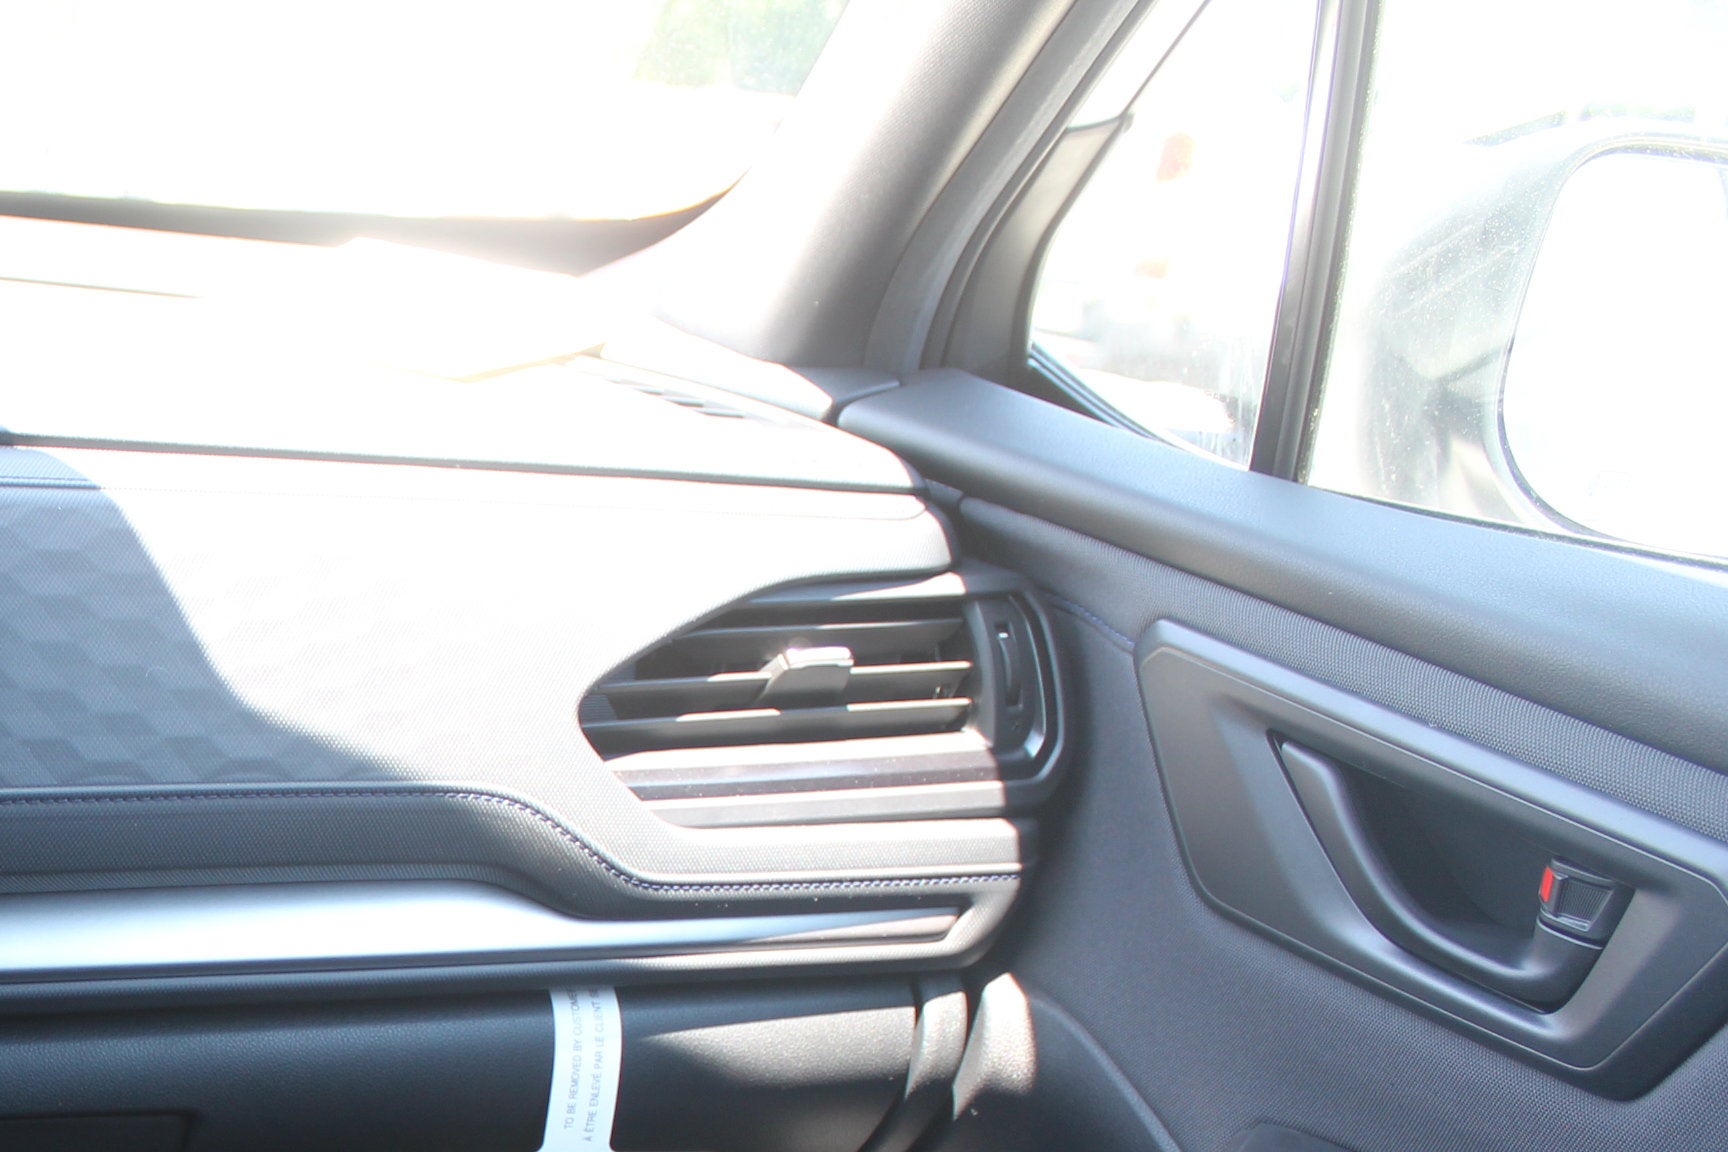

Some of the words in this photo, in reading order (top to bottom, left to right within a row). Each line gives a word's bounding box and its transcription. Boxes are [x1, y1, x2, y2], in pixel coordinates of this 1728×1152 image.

[569, 1056, 583, 1100] REMOVED
[566, 1102, 577, 1115] BE
[564, 1116, 575, 1130] TO
